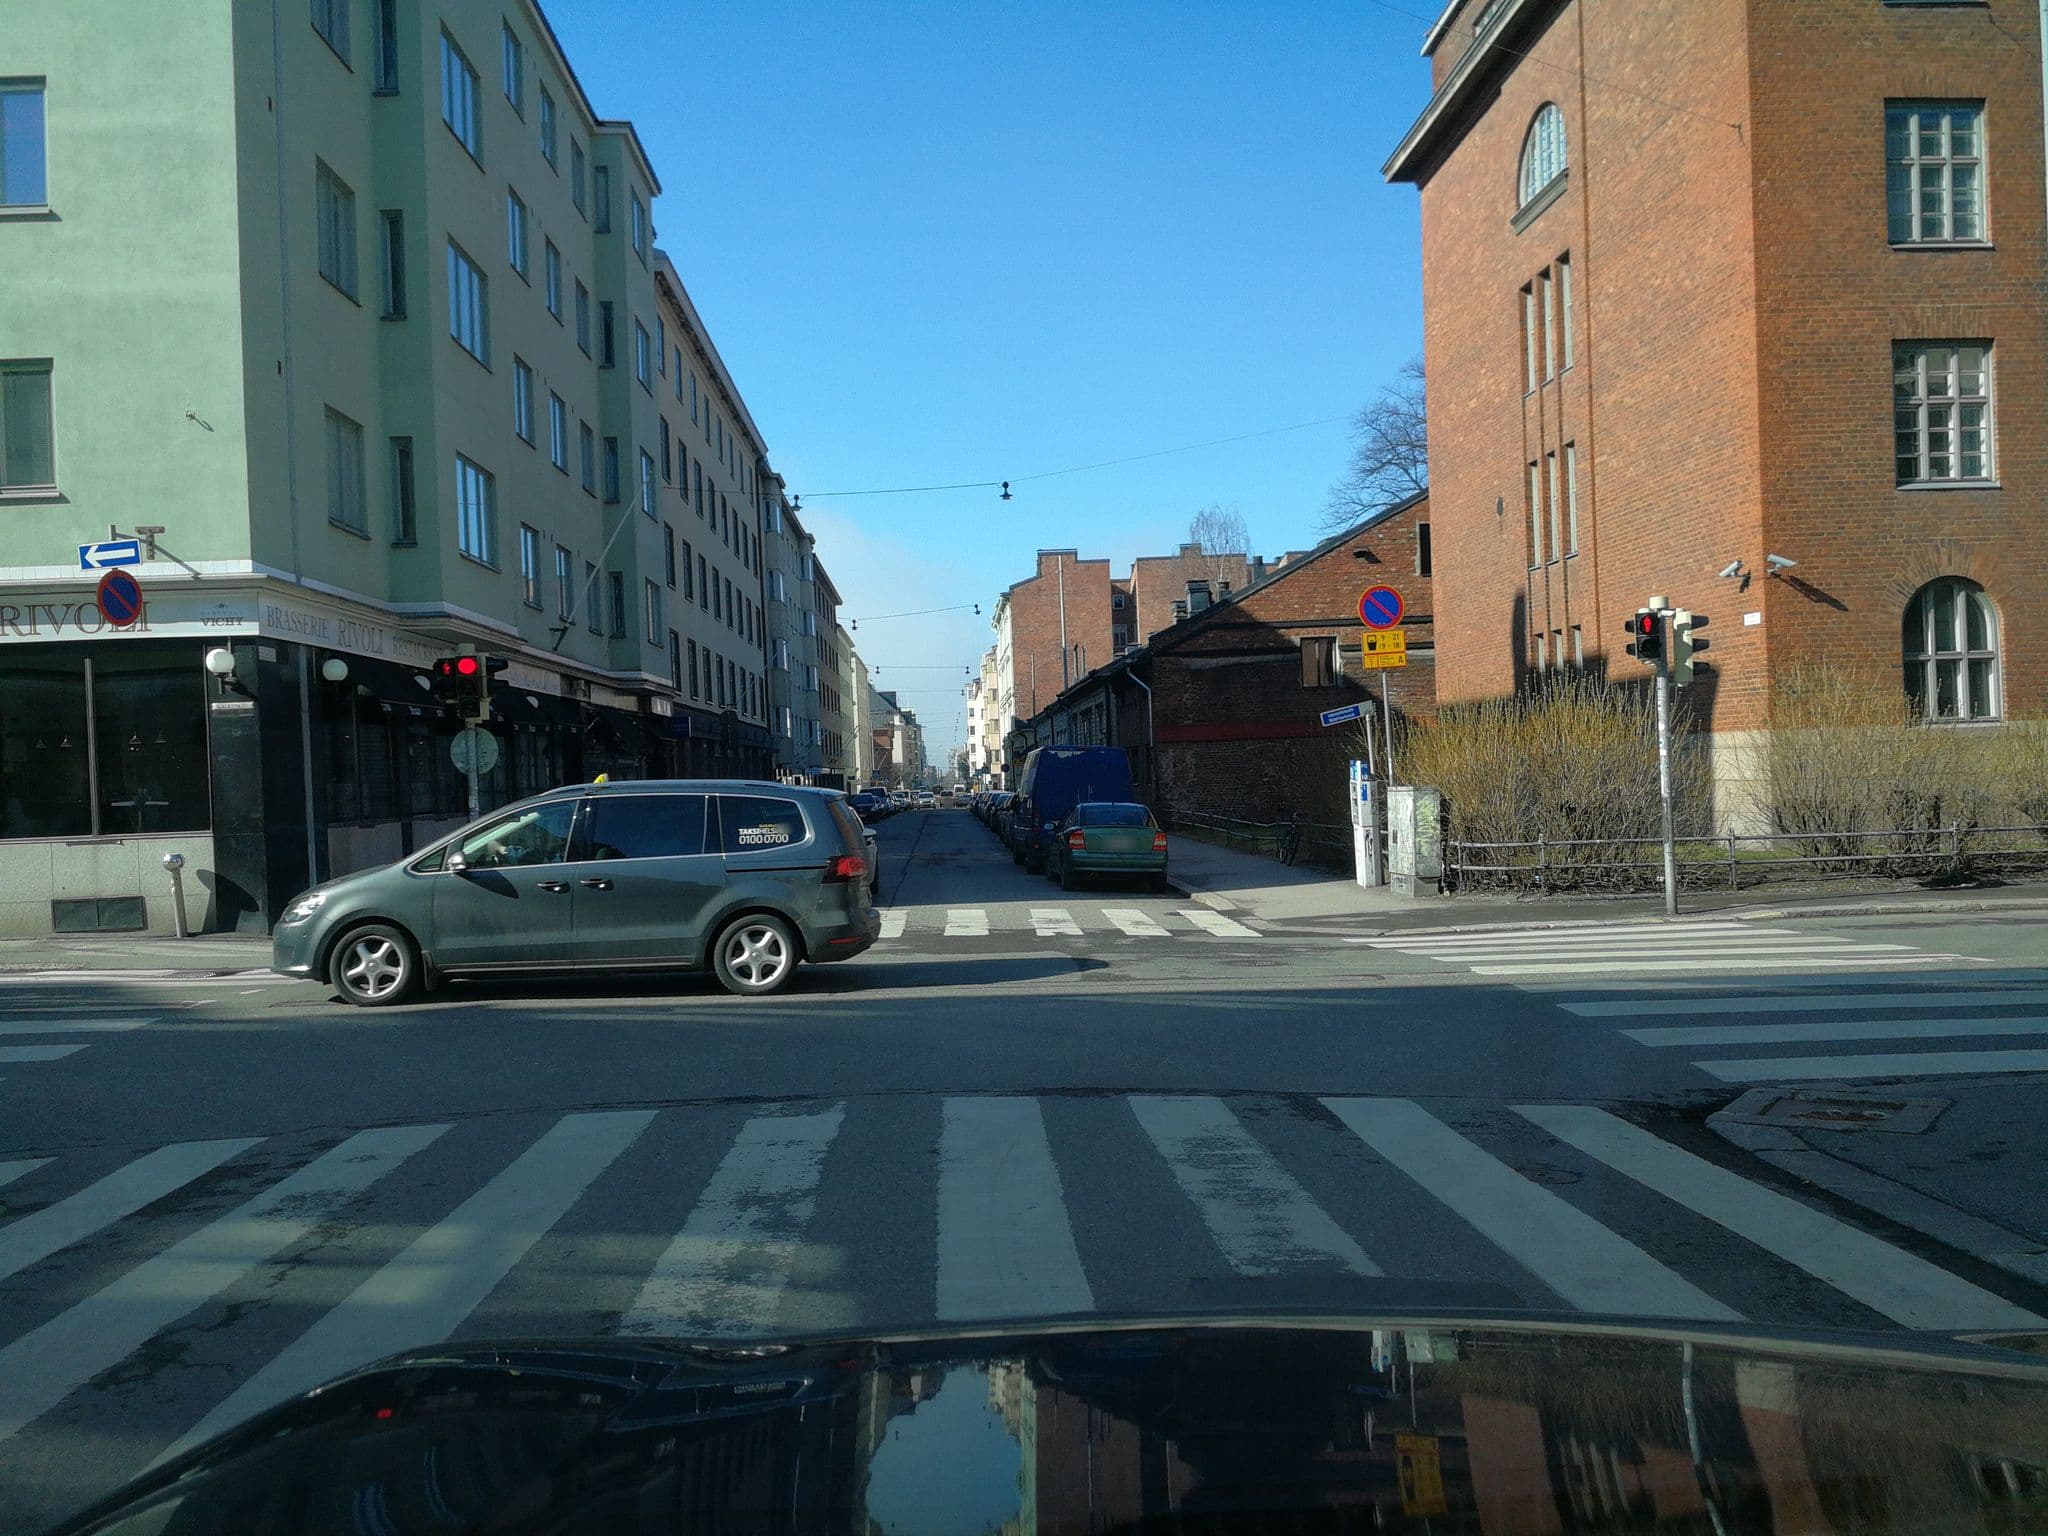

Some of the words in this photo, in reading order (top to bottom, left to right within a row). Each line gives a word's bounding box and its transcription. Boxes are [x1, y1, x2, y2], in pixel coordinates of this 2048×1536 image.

[0, 602, 152, 637] RIVOI
[200, 617, 243, 627] VICHY
[266, 605, 328, 639] BRASSERIE
[337, 619, 384, 655] RIVOLI
[739, 835, 763, 845] 0100
[764, 834, 789, 844] 0700
